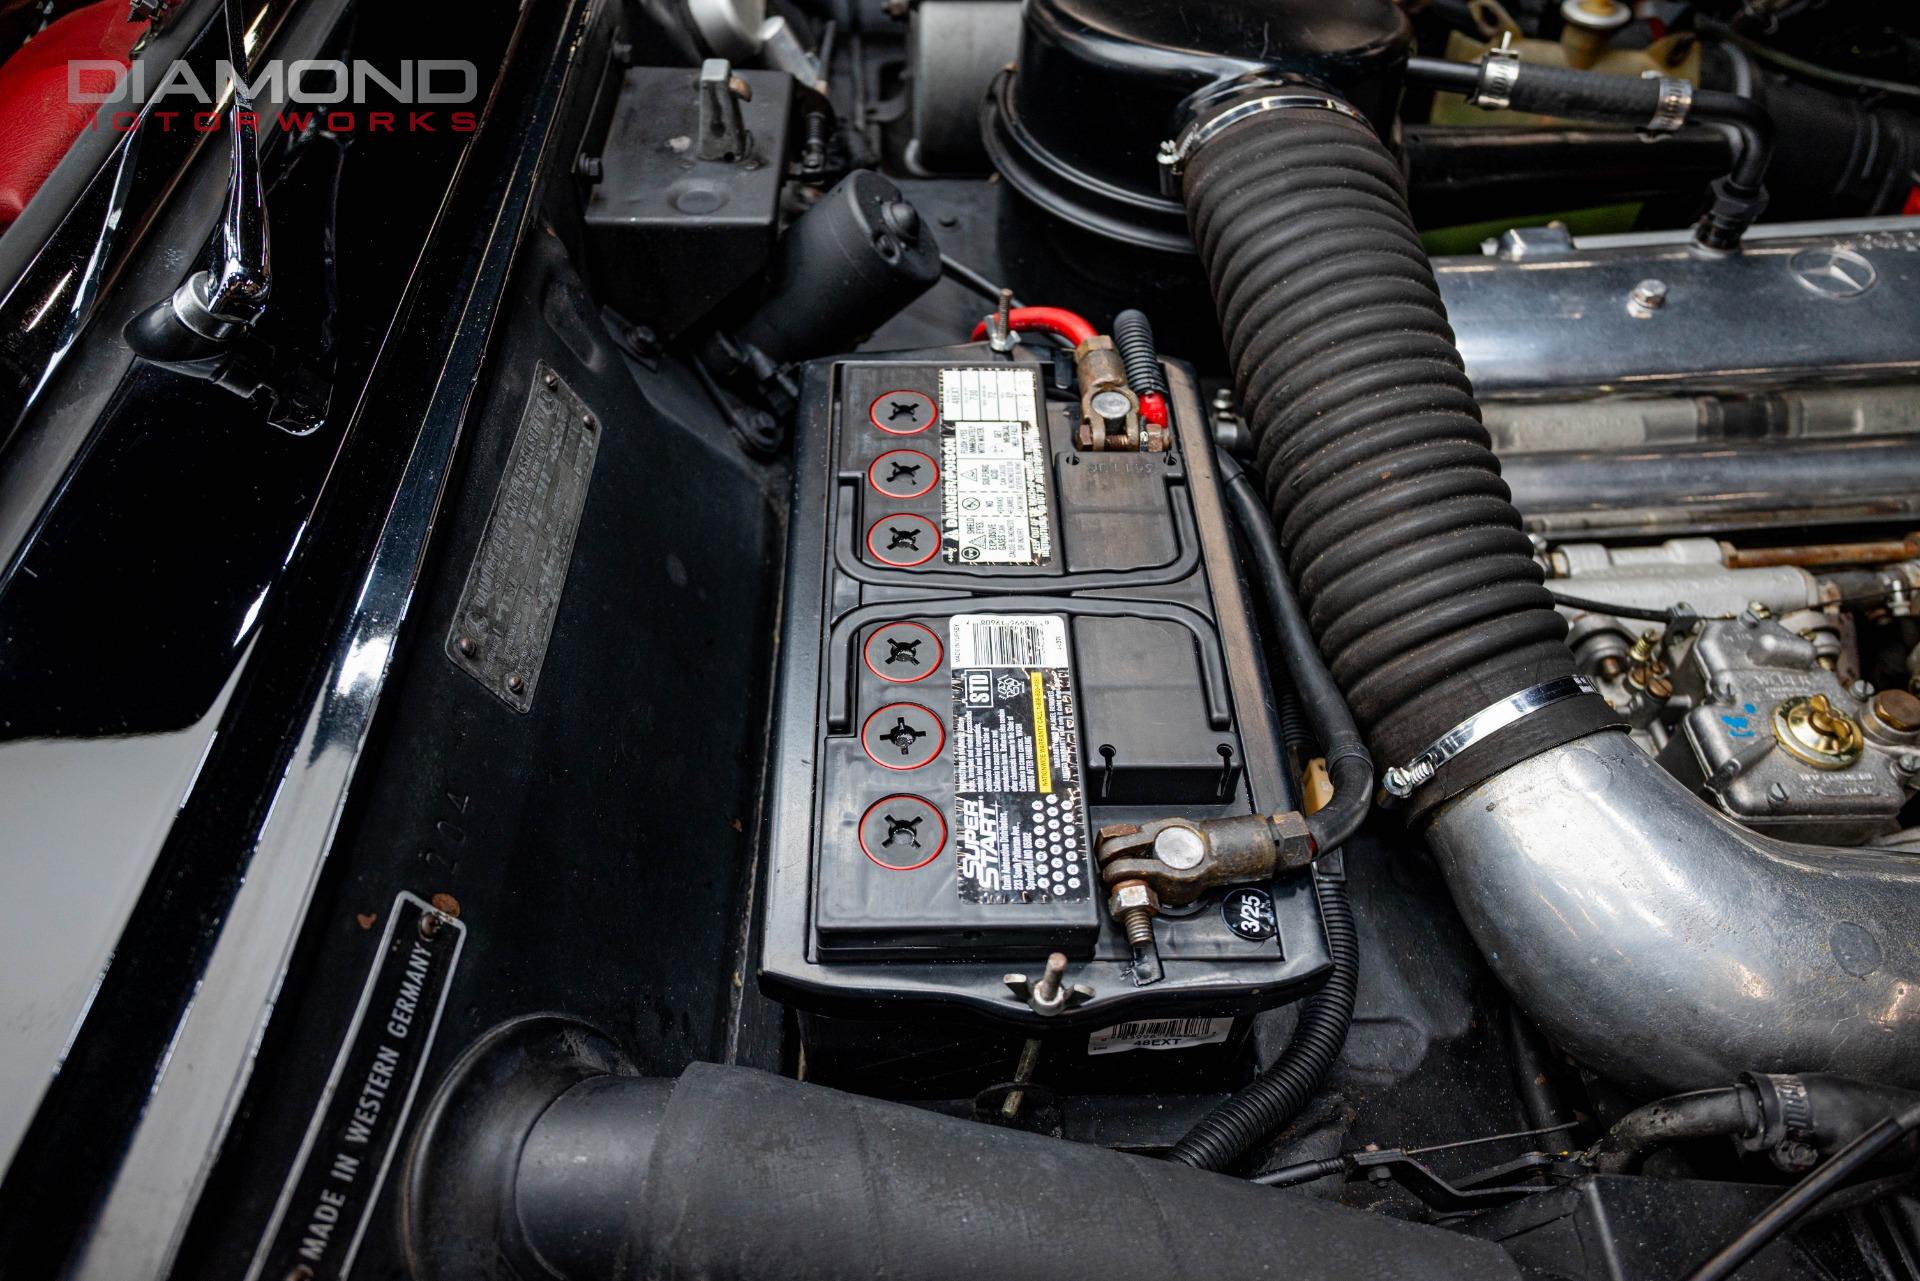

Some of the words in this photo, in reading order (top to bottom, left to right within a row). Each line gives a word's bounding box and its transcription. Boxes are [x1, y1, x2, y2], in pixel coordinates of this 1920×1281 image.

[988, 524, 997, 550] EXPLOSIVE
[998, 535, 1006, 550] GASES
[969, 675, 989, 704] STD
[962, 799, 981, 878] SUPER
[978, 799, 1000, 891] START
[1239, 894, 1260, 932] 3/25
[386, 940, 432, 1039] GERMANY
[1133, 1038, 1182, 1046] 48EXT
[344, 1045, 400, 1144] WESTERN
[330, 1152, 361, 1182] IN
[297, 1188, 347, 1262] MADE
